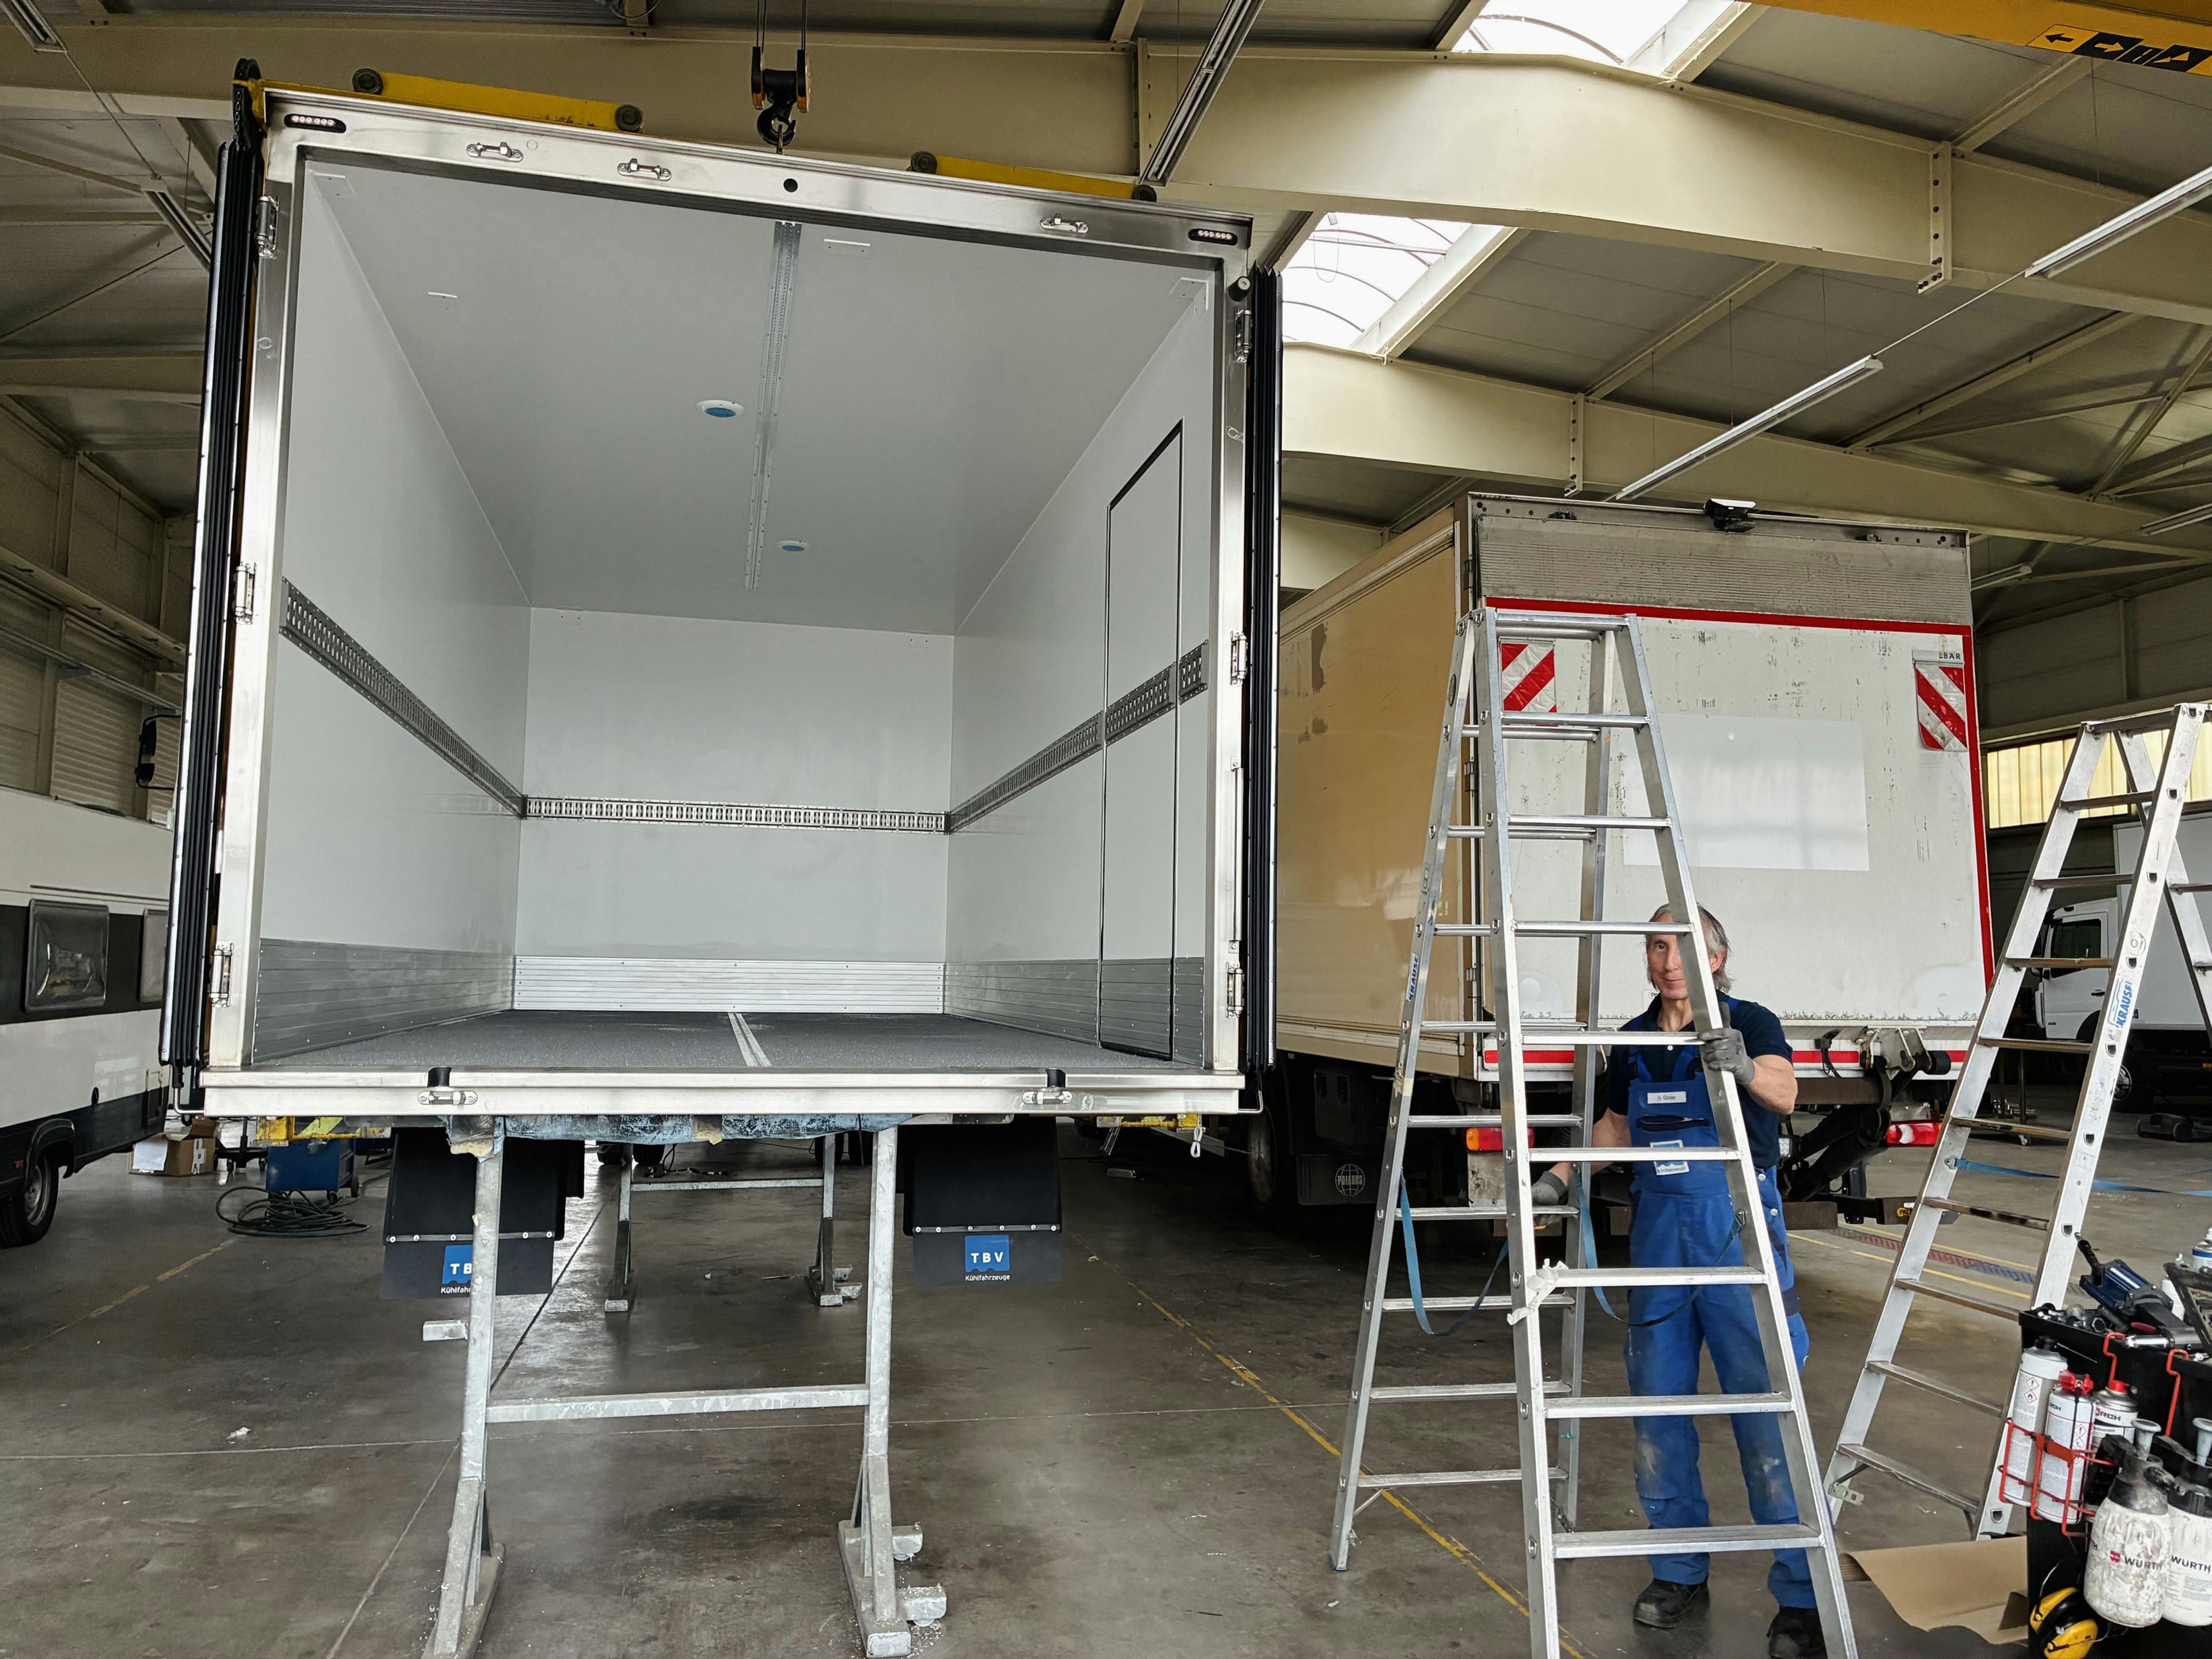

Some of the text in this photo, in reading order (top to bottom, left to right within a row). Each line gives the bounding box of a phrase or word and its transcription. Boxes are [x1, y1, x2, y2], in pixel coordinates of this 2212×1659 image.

[1943, 652, 1961, 660] BAR
[1408, 955, 1418, 1001] KRAUSE
[970, 1252, 1003, 1263] TBV
